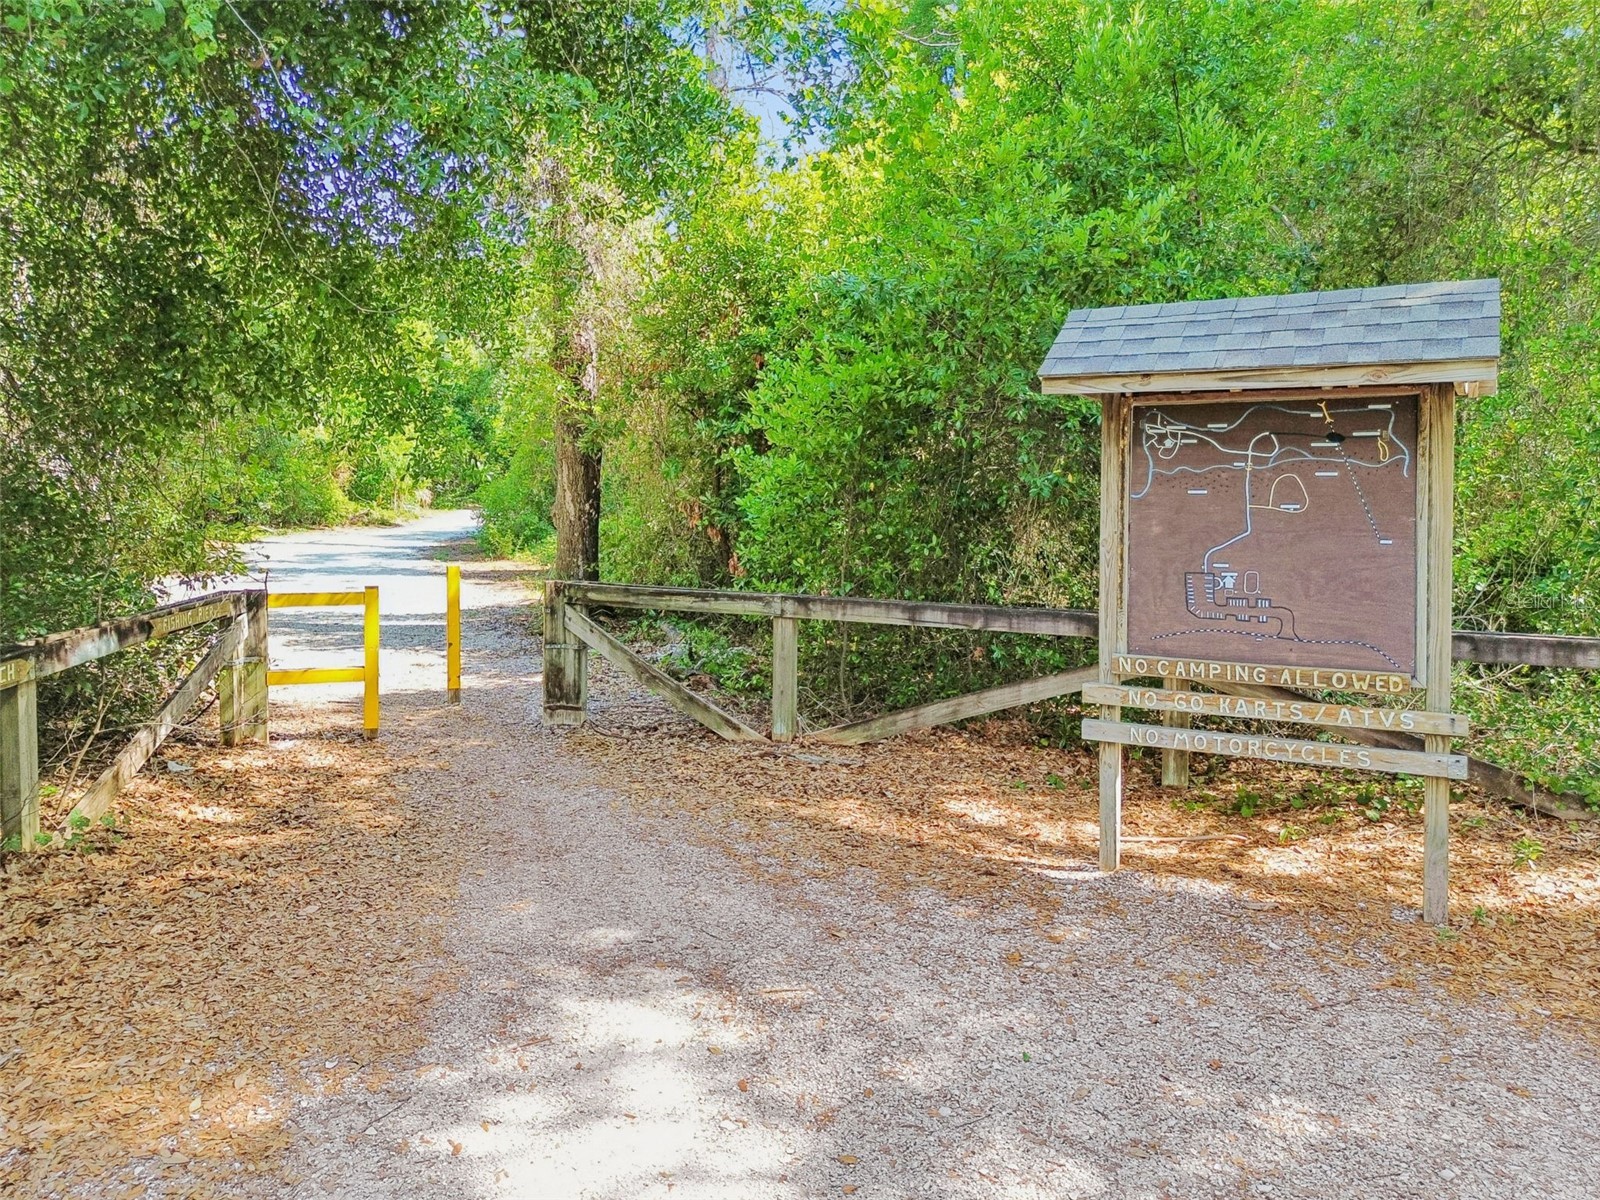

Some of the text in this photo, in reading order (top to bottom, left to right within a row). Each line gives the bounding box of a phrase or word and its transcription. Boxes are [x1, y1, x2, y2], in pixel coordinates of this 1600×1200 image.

[163, 609, 193, 631] FISHING
[1118, 656, 1403, 693] NO CAMPING ALLOWED
[1128, 690, 1157, 707] NO
[1174, 694, 1204, 711] GO
[1130, 727, 1371, 767] NO MOTORCYCLES
